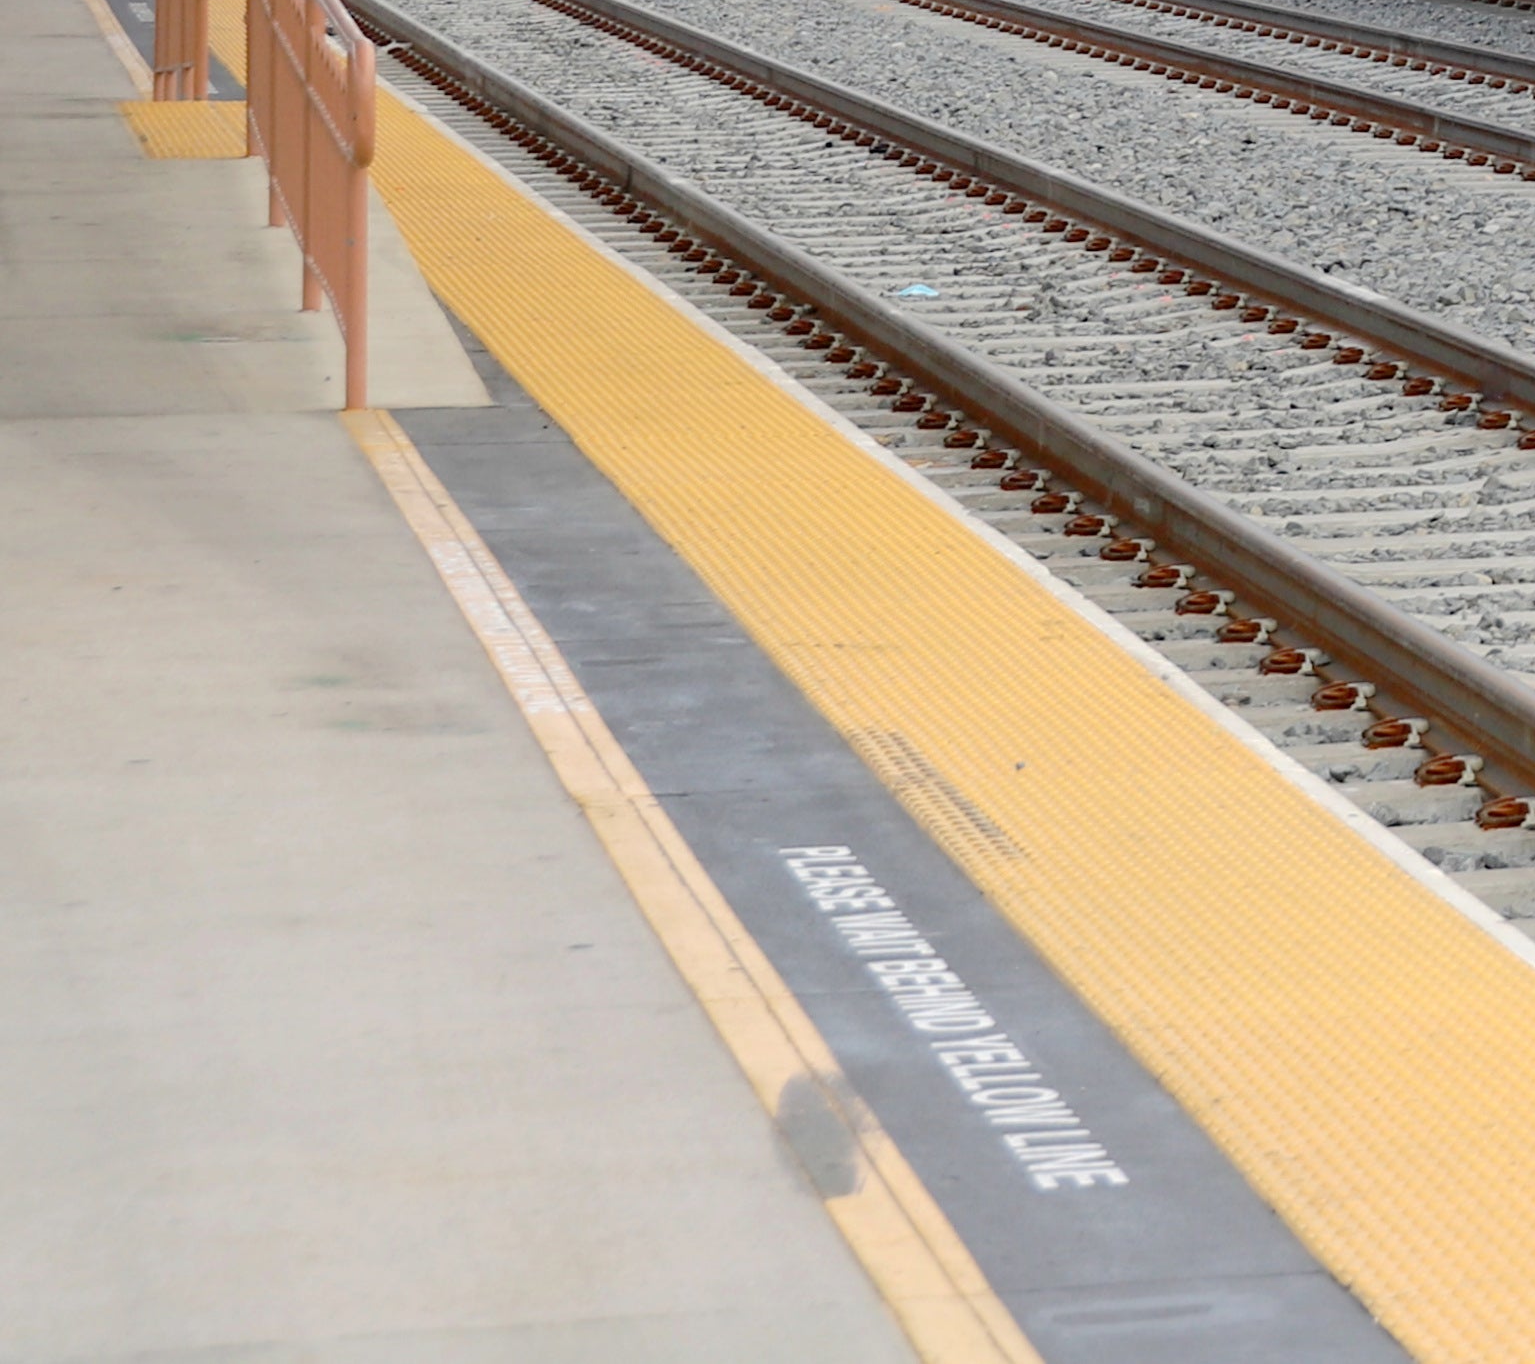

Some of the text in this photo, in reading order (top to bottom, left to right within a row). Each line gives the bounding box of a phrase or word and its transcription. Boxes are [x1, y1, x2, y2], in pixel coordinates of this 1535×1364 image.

[778, 845, 1130, 1190] PLEASE WAIT BEHIND YELLOW LINE
